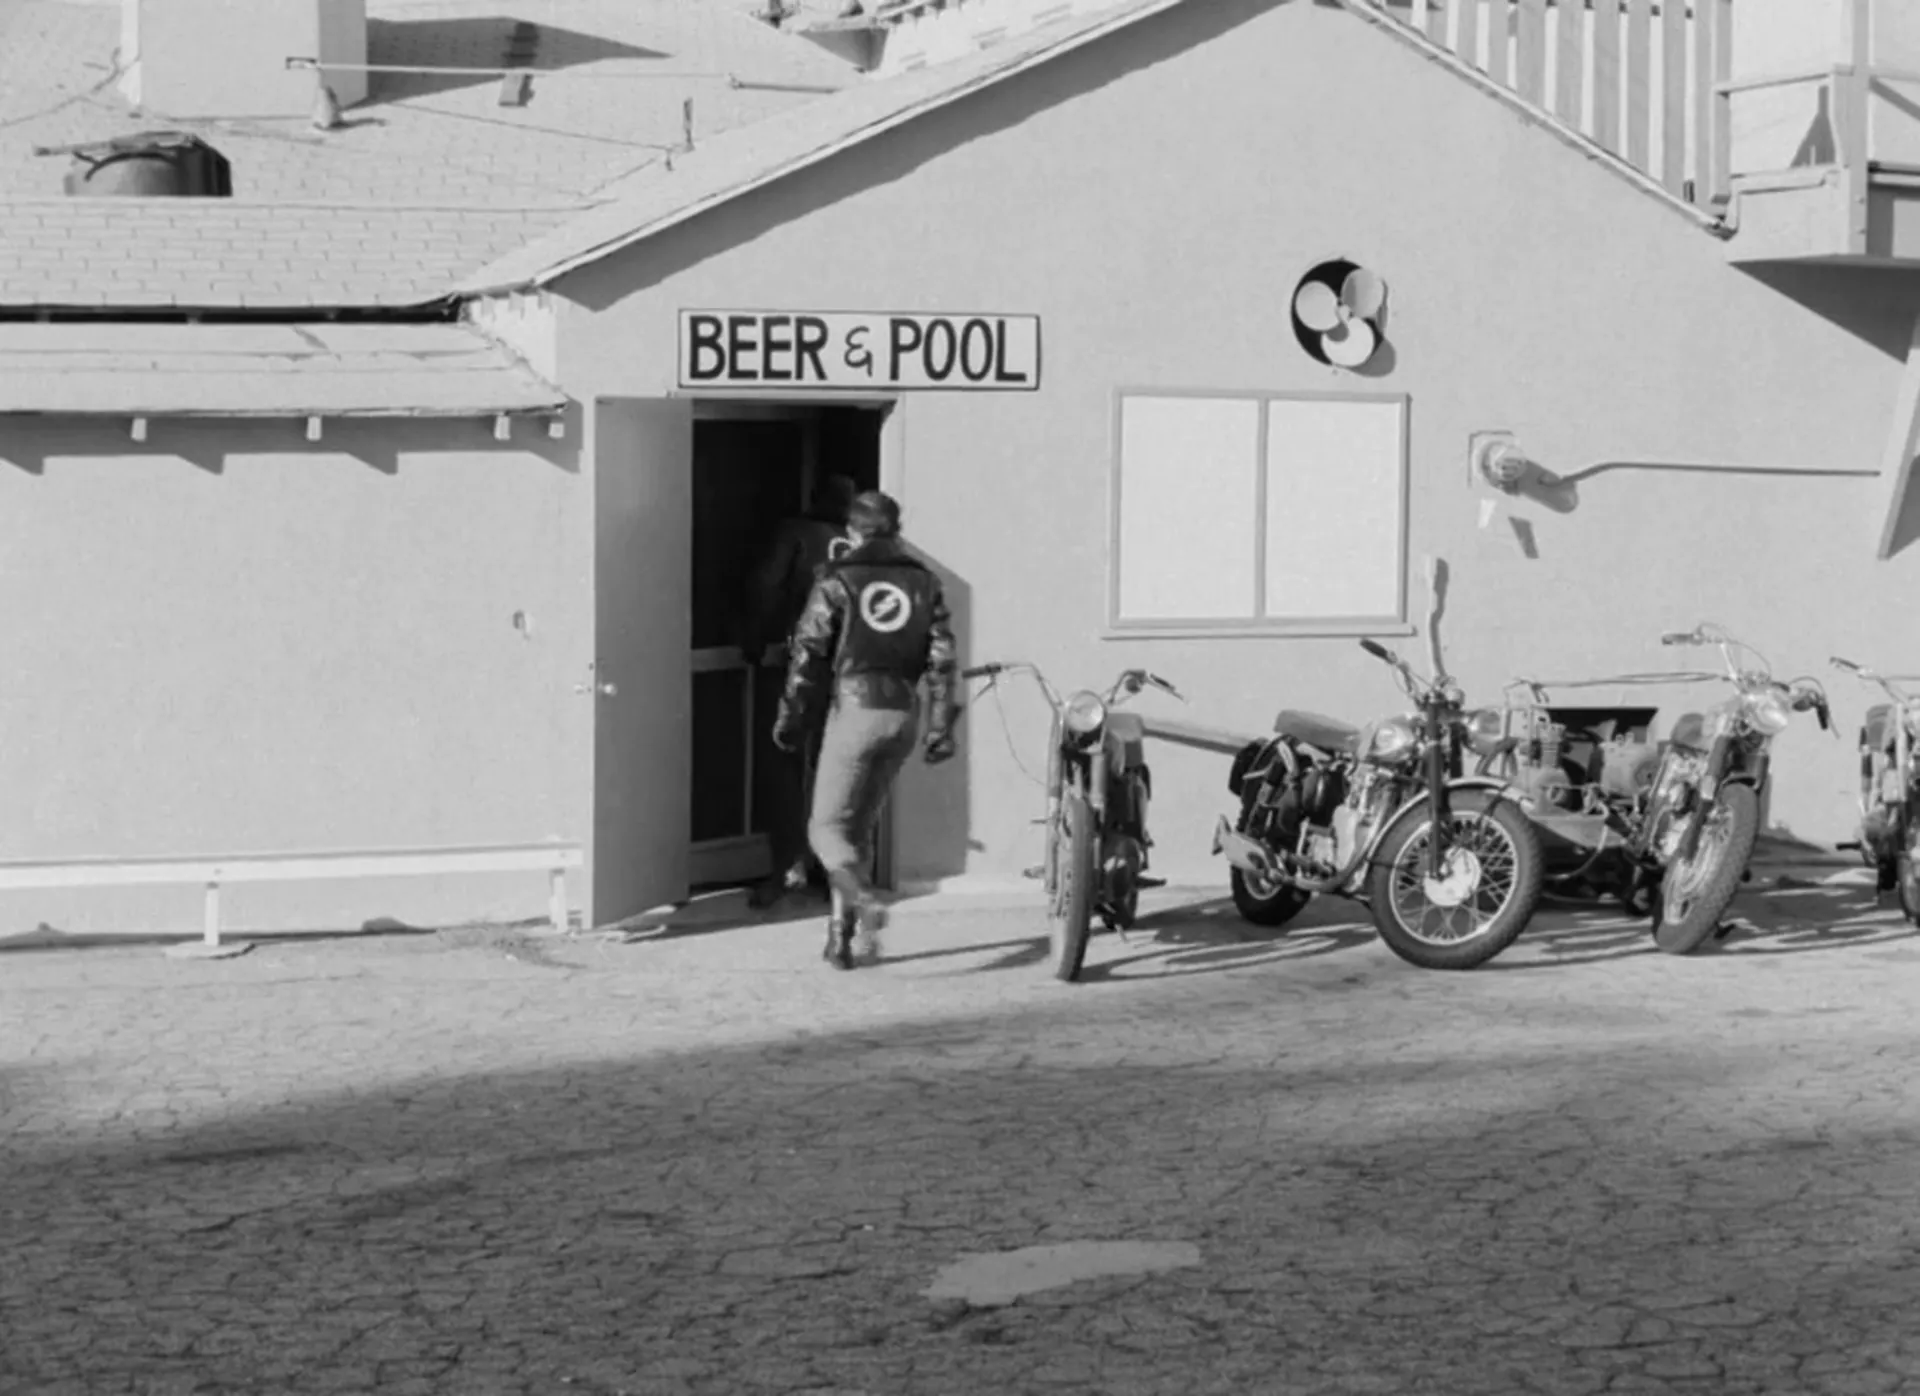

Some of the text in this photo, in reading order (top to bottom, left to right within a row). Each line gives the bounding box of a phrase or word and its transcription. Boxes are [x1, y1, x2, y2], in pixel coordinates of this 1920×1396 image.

[689, 315, 1027, 382] BEER & POOL
